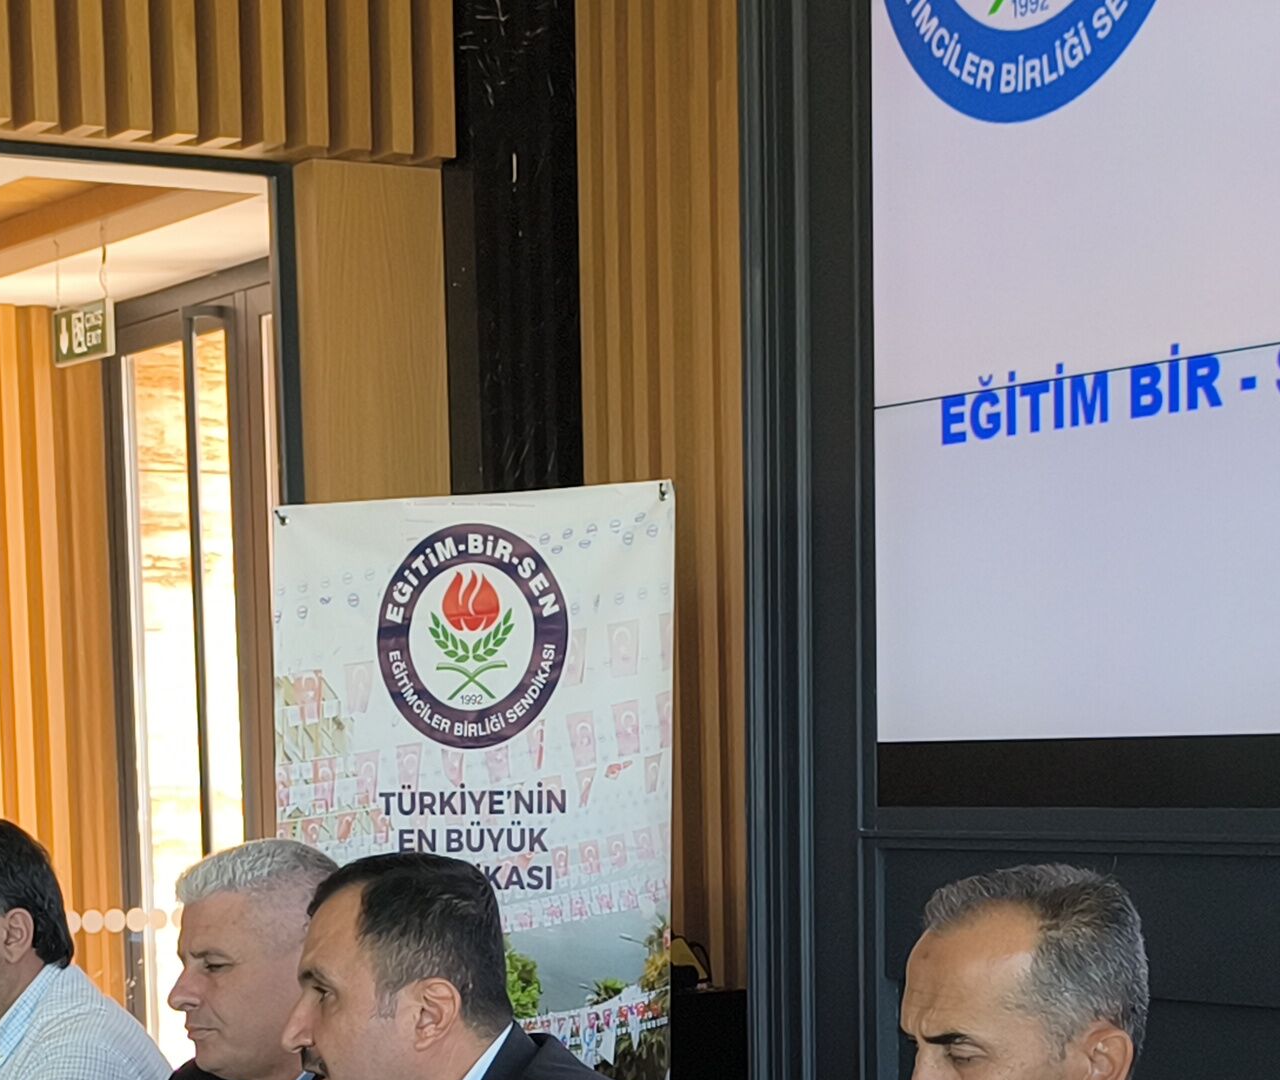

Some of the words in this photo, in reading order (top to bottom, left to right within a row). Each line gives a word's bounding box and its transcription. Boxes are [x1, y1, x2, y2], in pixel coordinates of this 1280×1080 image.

[999, 21, 1091, 94] BİRLİĞİ
[941, 362, 1109, 446] EĞİTİM
[1130, 342, 1223, 420] BİR
[388, 650, 451, 733] EĞİTİMCİLER
[453, 711, 507, 738] BİRLİĞİ
[507, 643, 557, 724] SENDİKASI
[378, 781, 567, 817] TÜRKİYE'NİN
[398, 828, 437, 854] EN
[445, 820, 549, 853] BÜYÜK
